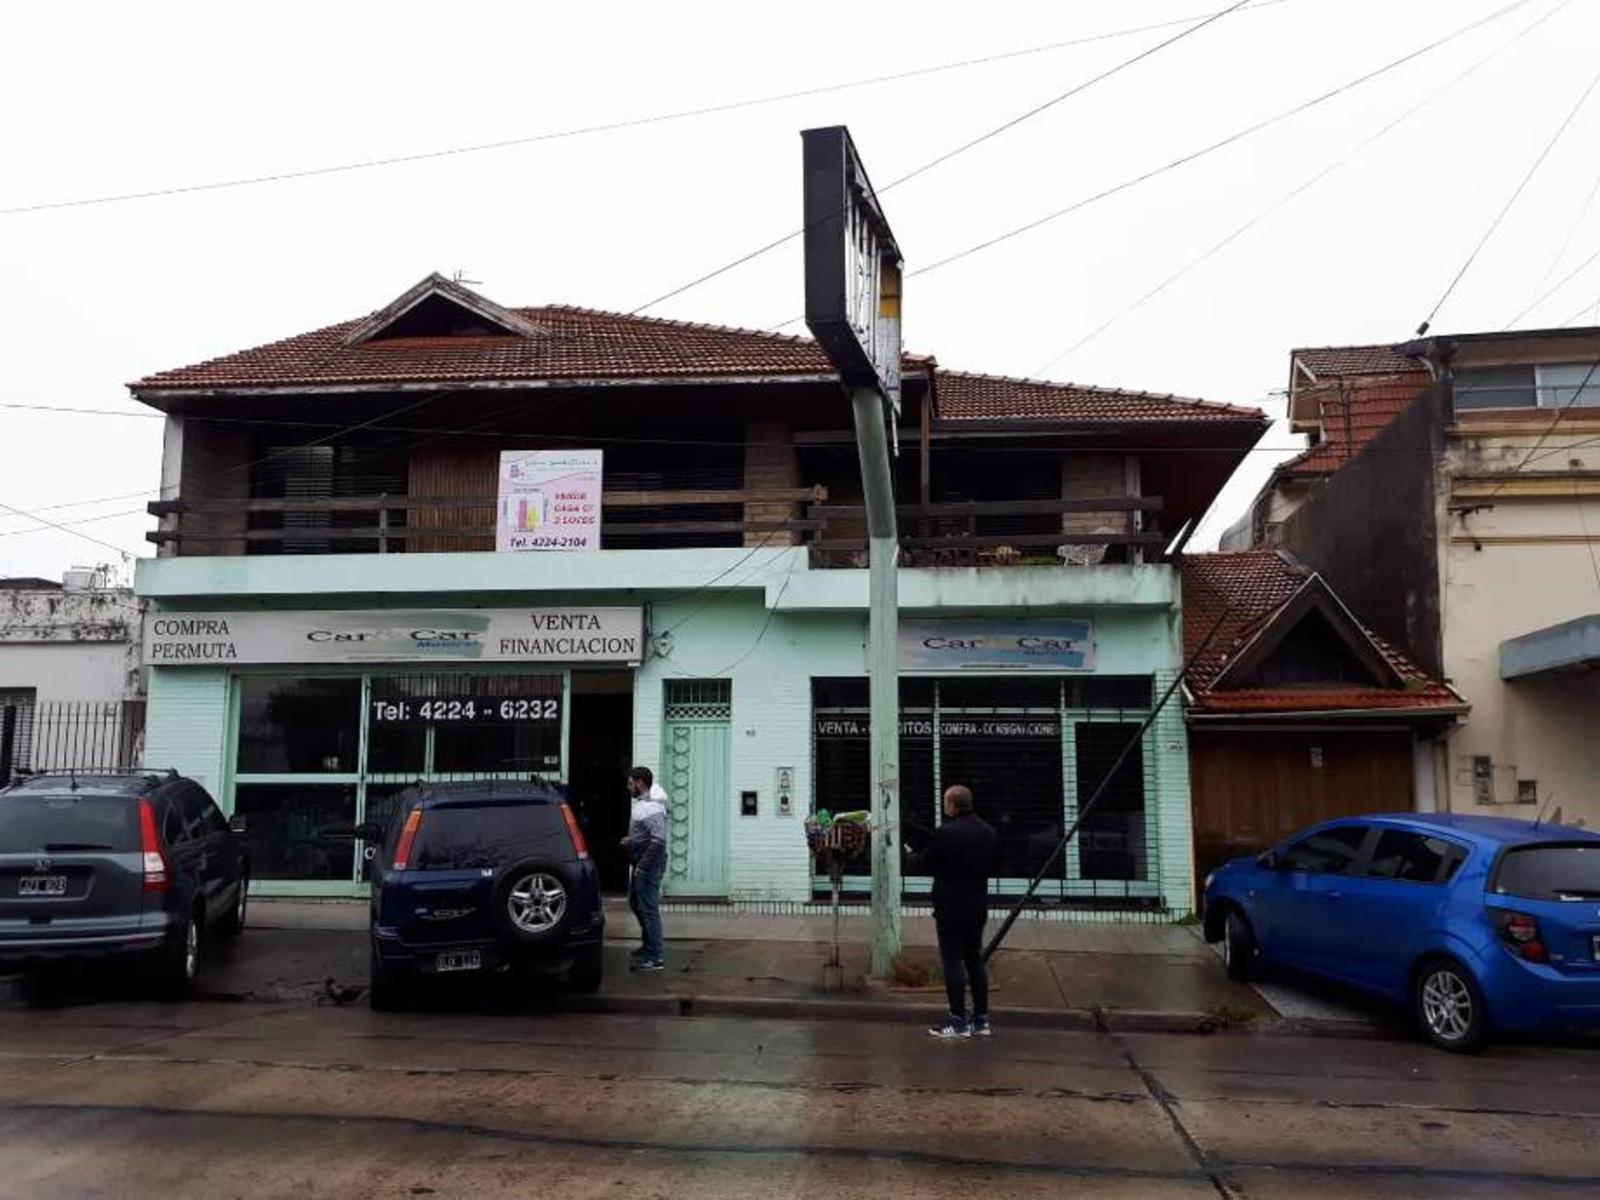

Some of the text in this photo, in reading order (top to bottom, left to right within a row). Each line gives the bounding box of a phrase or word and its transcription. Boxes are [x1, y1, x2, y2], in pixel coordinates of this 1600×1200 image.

[510, 537, 587, 548] Tel. 4224-2104
[154, 619, 229, 636] COMPRA
[531, 614, 601, 631] VENTA
[306, 630, 371, 643] Car
[410, 629, 479, 642] Car
[922, 637, 982, 650] Car
[1016, 637, 1077, 649] Car
[152, 642, 237, 659] PERMUTA
[499, 637, 636, 655] FINANCIACION
[373, 702, 410, 721] Tel:
[419, 701, 476, 720] 4224
[500, 700, 558, 719] 6232
[818, 721, 859, 735] VENTA
